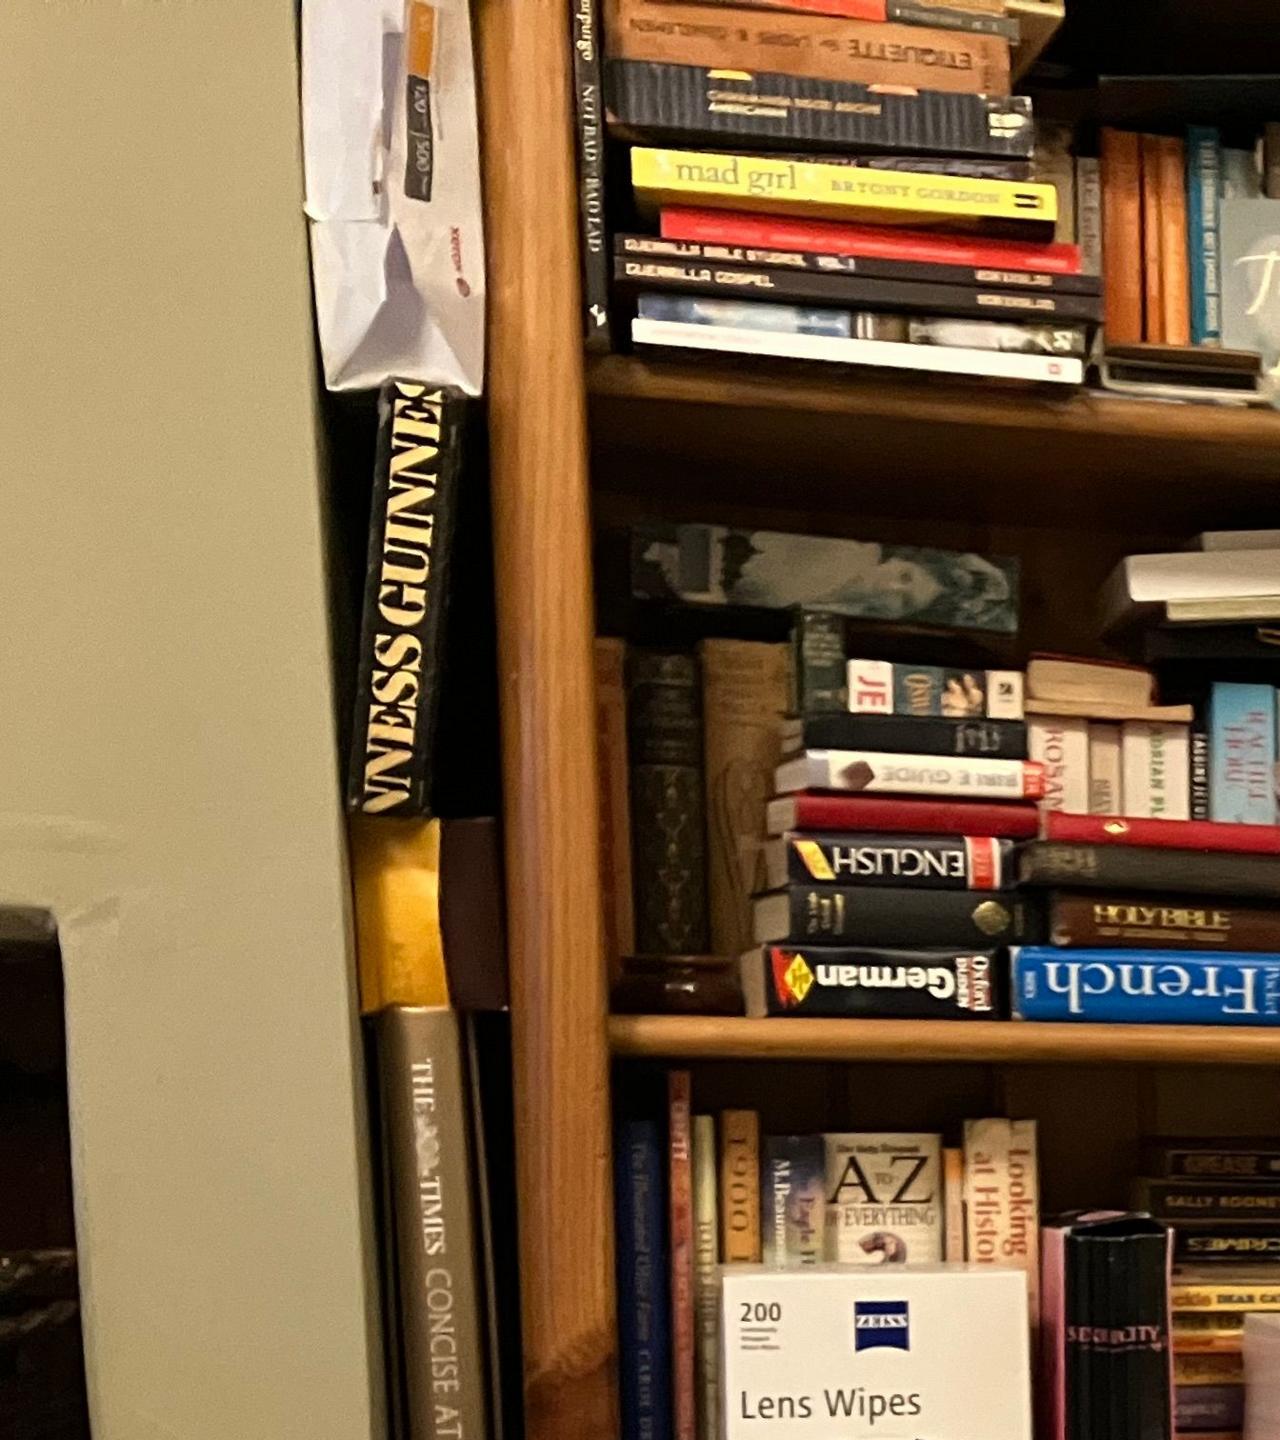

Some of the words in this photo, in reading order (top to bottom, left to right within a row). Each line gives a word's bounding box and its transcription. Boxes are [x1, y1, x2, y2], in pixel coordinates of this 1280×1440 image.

[848, 38, 974, 71] ETIQUETTE
[676, 157, 739, 185] mad
[747, 165, 797, 195] girl
[830, 179, 911, 199] BRYONY
[916, 186, 999, 206] GORDON
[625, 262, 711, 282] GUERRILLA
[715, 270, 775, 289] GOSPEL
[379, 383, 442, 627] GUINNE
[881, 768, 952, 787] GUIDE
[835, 845, 965, 878] ENGLISH
[1095, 904, 1162, 926] HOLY
[1163, 908, 1231, 930] BIBLE
[816, 964, 955, 1000] German
[972, 956, 991, 1012] Oxford
[1046, 962, 1259, 1014] French
[411, 1058, 434, 1111] THE
[827, 1156, 879, 1204] A
[890, 1155, 934, 1204] Z
[419, 1175, 446, 1256] TIMES
[845, 1207, 937, 1227] EVERYTHING
[1002, 1148, 1033, 1255] Looking
[1166, 1194, 1214, 1208] SALLY
[424, 1267, 460, 1393] CONCISE
[740, 1301, 782, 1324] 200
[855, 1313, 908, 1330] ZEISS
[638, 1347, 653, 1409] CAROL
[741, 1390, 813, 1420] Lens
[824, 1387, 922, 1426] Wipes
